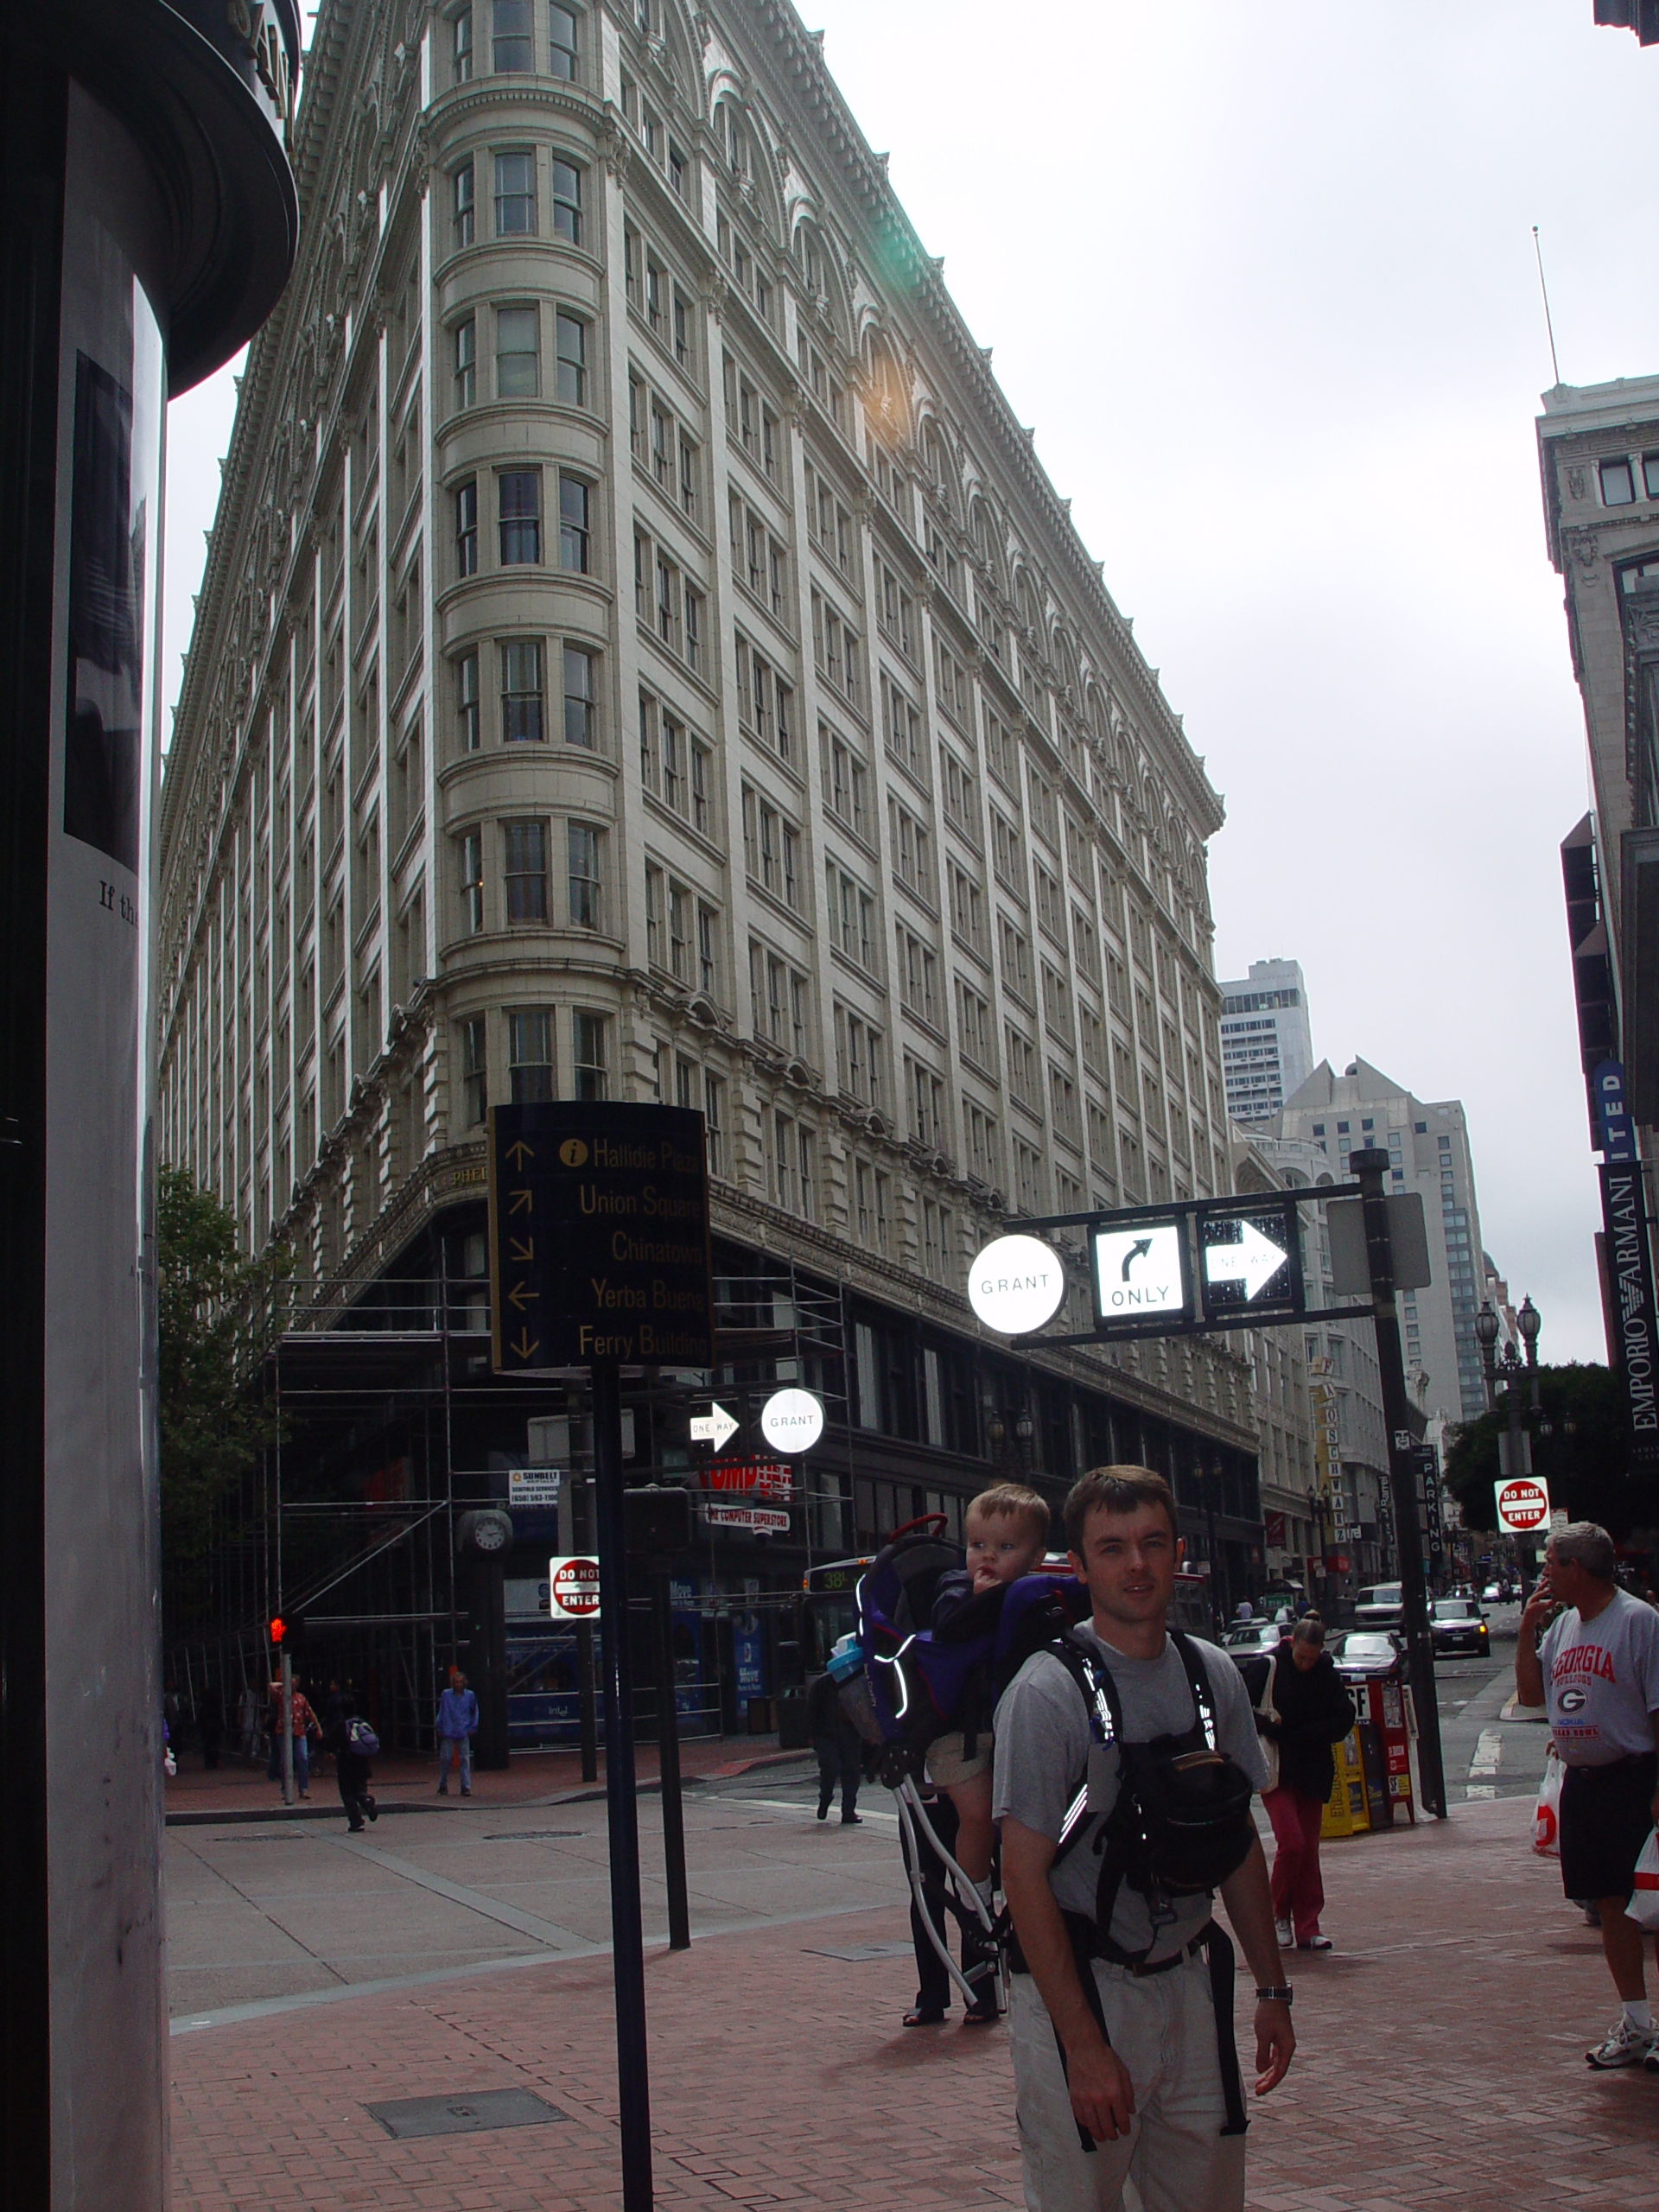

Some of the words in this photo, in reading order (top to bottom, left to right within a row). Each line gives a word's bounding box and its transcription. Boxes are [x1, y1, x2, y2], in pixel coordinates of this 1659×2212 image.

[99, 880, 115, 912] If
[120, 893, 138, 930] th
[594, 1138, 657, 1168] Hallidie
[661, 1141, 699, 1173] Plaza
[580, 1185, 637, 1214] Union
[643, 1185, 701, 1222] Square
[1608, 1175, 1642, 1282] ARMANI
[612, 1230, 702, 1265] Chinatown
[981, 1274, 1049, 1294] GRANT
[591, 1278, 646, 1309] Yerba
[652, 1279, 704, 1313] Buena
[1111, 1285, 1169, 1306] ONLY
[580, 1325, 632, 1361] Ferry
[639, 1324, 707, 1362] Building
[1623, 1318, 1658, 1431] EMPORIO
[693, 1423, 710, 1433] ONE
[716, 1421, 734, 1431] WAY
[770, 1414, 815, 1427] GRANT
[523, 1471, 557, 1480] SUNBELT
[1503, 1489, 1517, 1500] DO
[1521, 1488, 1539, 1498] NOT
[1424, 1463, 1441, 1552] PARKING
[1508, 1510, 1541, 1522] ENTER
[721, 1510, 752, 1522] COMPUTER
[753, 1511, 787, 1527] SUPERSTORE
[559, 1569, 575, 1580] DO
[580, 1569, 600, 1580] NOT
[562, 1594, 600, 1606] ENTER
[1573, 1728, 1599, 1737] BOWL
